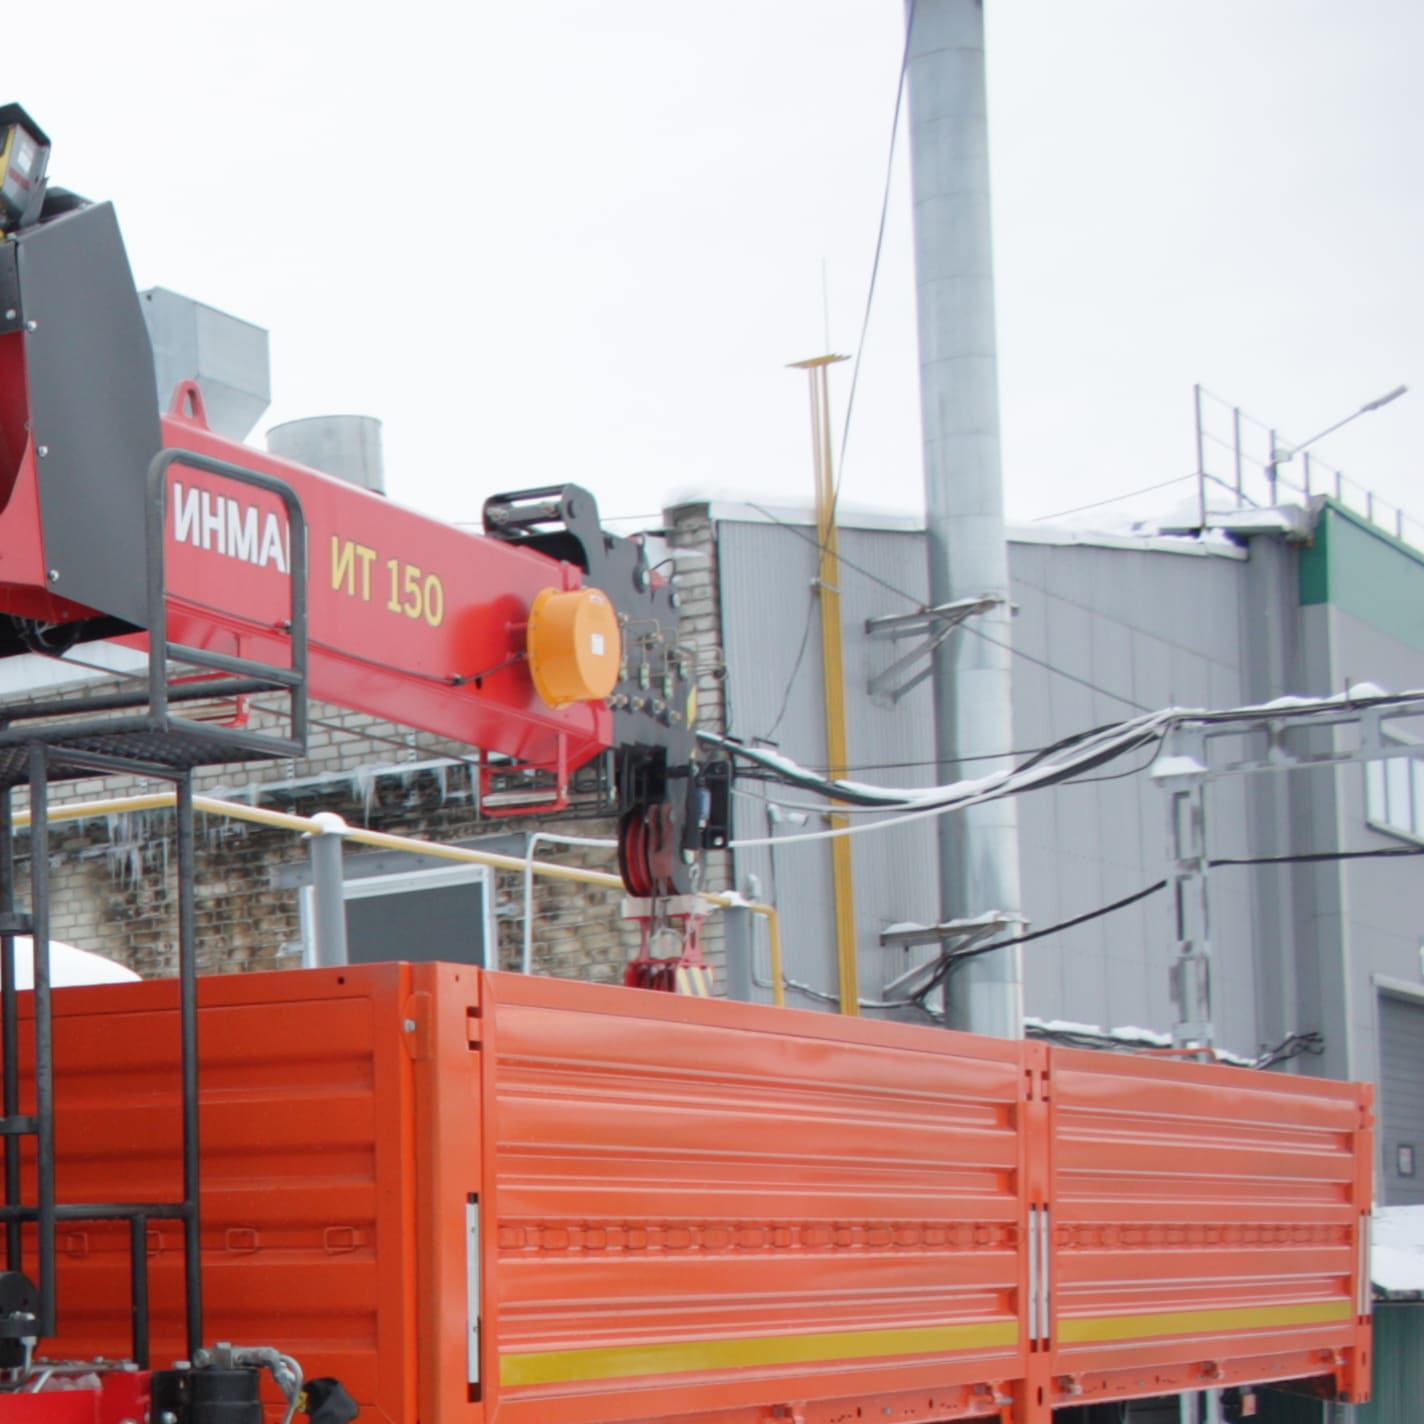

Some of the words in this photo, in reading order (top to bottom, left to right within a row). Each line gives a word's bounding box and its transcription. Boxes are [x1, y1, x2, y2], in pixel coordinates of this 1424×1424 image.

[173, 482, 308, 584] ИНМА
[331, 535, 376, 602] ИТ
[386, 559, 444, 628] 150
